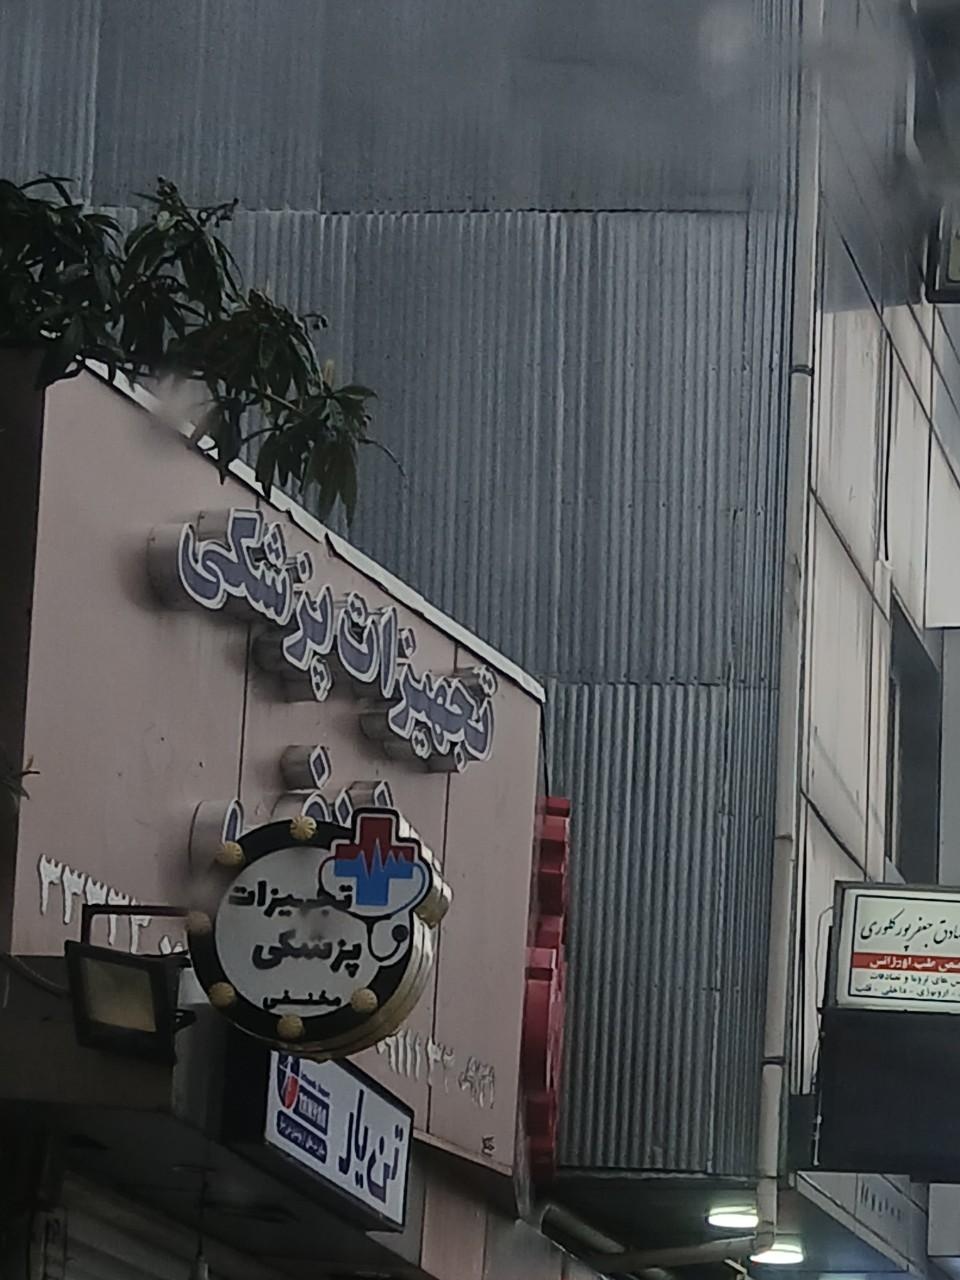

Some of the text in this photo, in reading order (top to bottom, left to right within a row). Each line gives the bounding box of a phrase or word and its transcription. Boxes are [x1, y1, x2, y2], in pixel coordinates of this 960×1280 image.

[178, 507, 498, 772] تجهیزات پزشکی
[252, 928, 362, 978] پزشکی
[869, 955, 912, 969] اورژانس
[914, 957, 937, 969] طب
